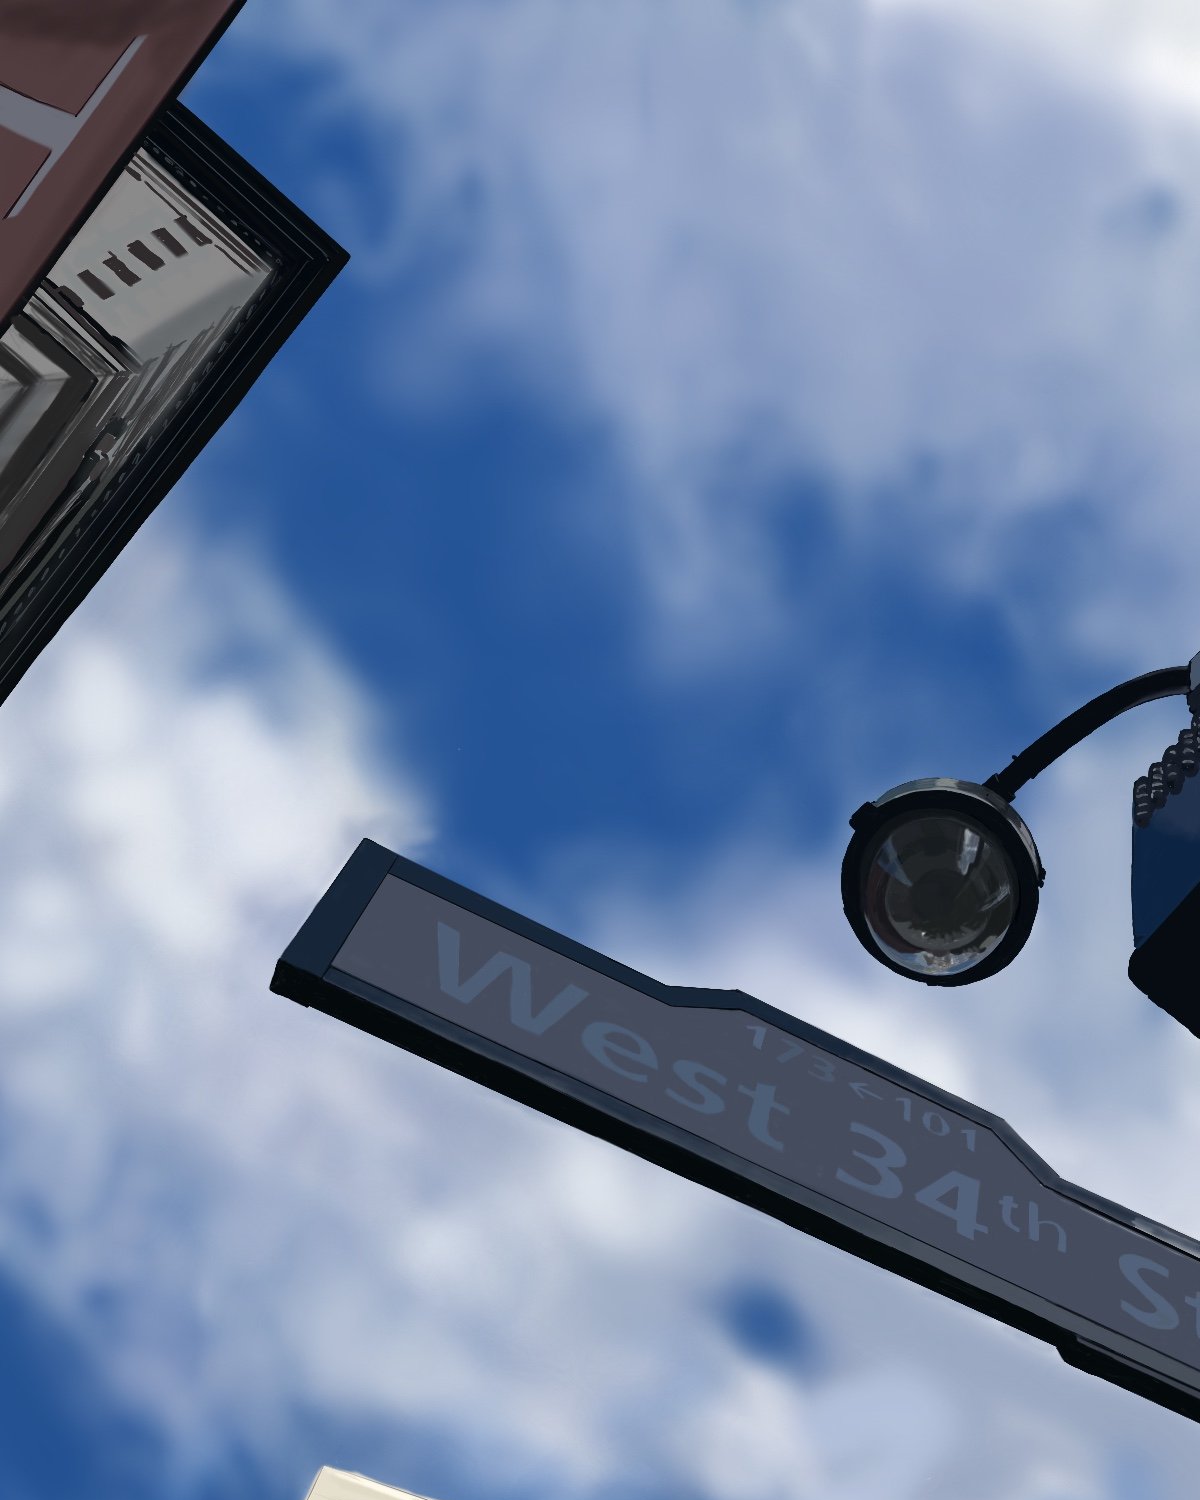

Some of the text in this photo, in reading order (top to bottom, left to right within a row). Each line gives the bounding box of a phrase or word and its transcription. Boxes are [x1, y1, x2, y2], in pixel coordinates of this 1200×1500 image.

[436, 921, 791, 1152] West
[834, 1121, 1067, 1253] 34th
[746, 1025, 976, 1152] 173 101
